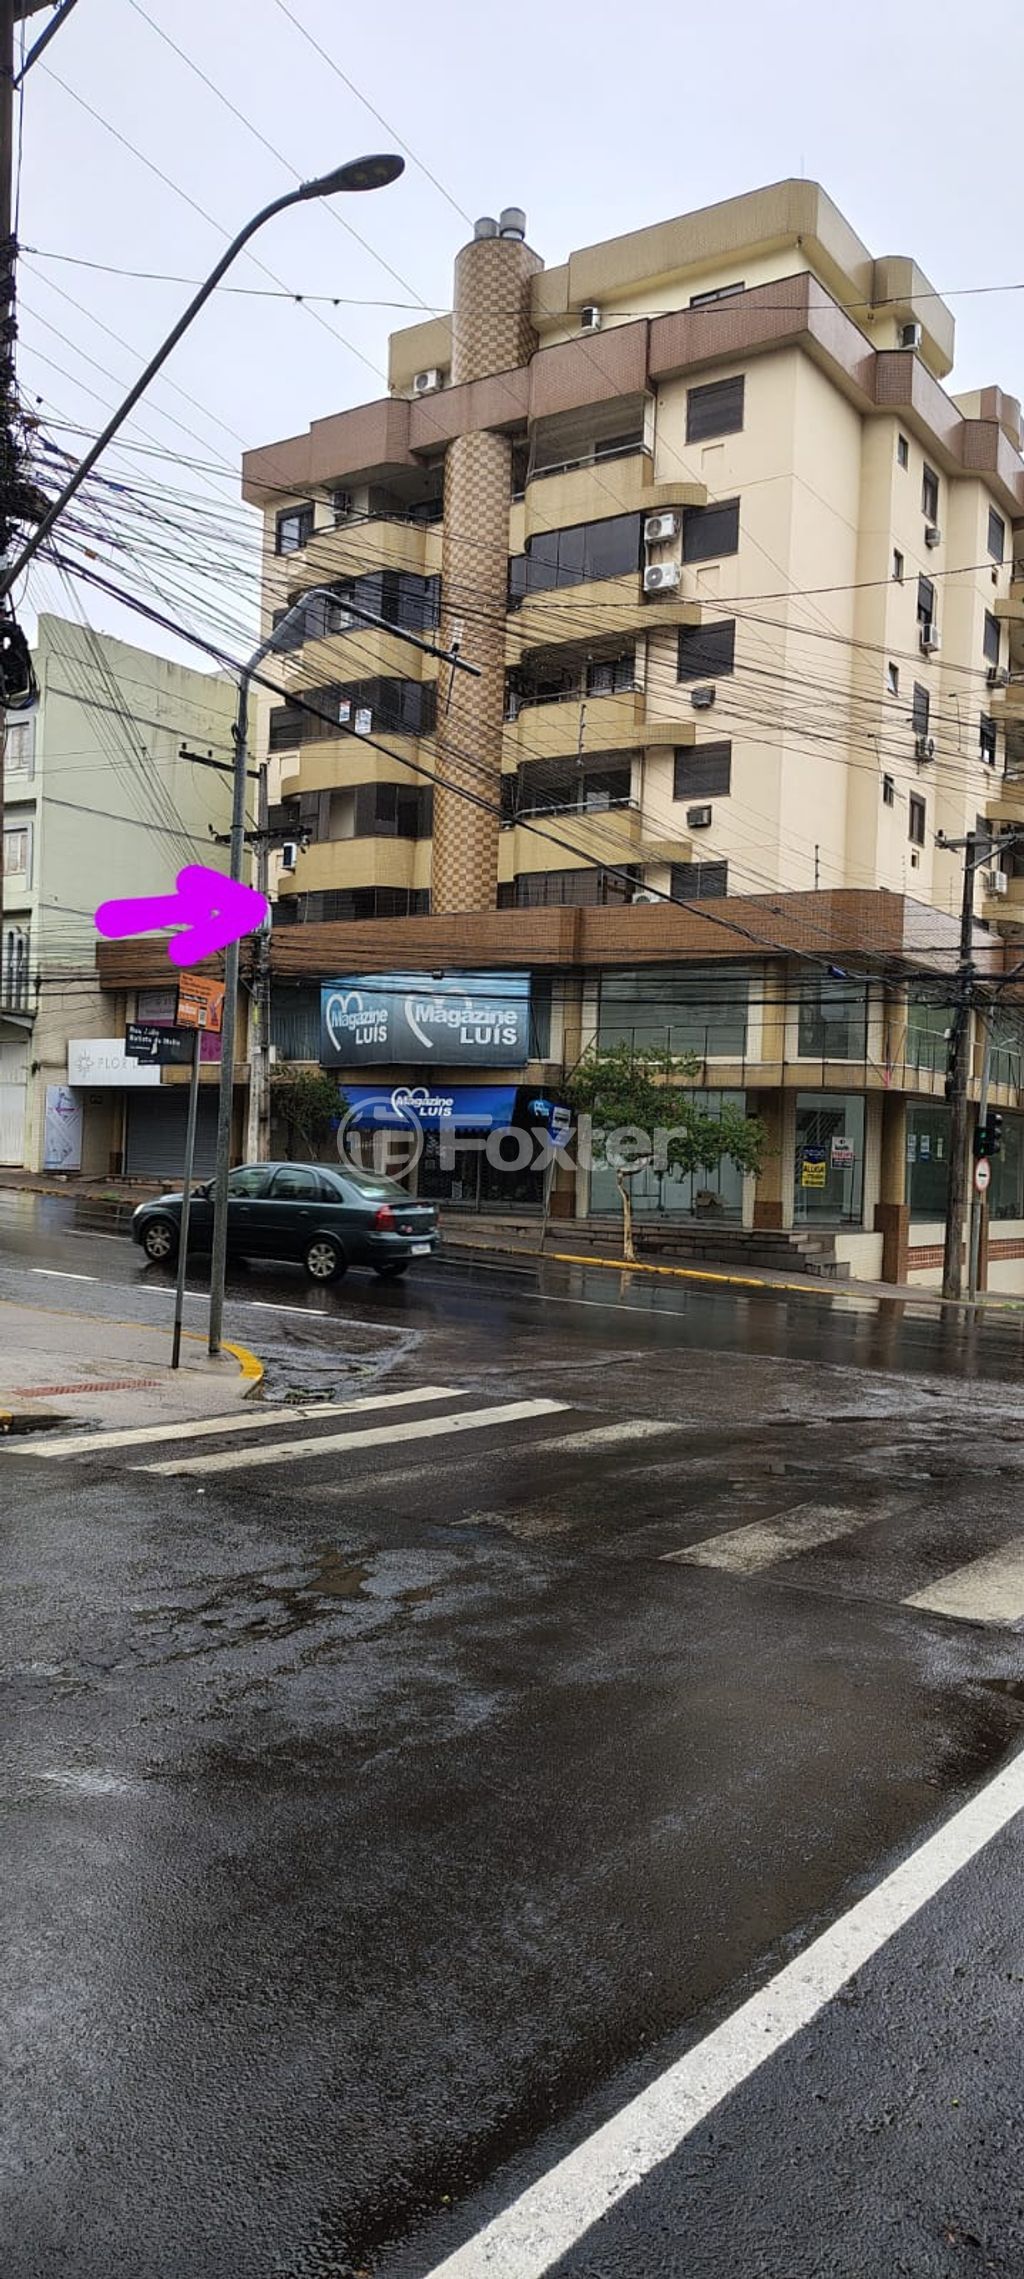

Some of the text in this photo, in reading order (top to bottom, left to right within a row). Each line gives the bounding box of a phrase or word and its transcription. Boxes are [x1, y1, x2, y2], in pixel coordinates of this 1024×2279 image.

[331, 1007, 388, 1031] Magazine
[415, 1003, 517, 1027] Magazine
[396, 1095, 454, 1107] Magazine
